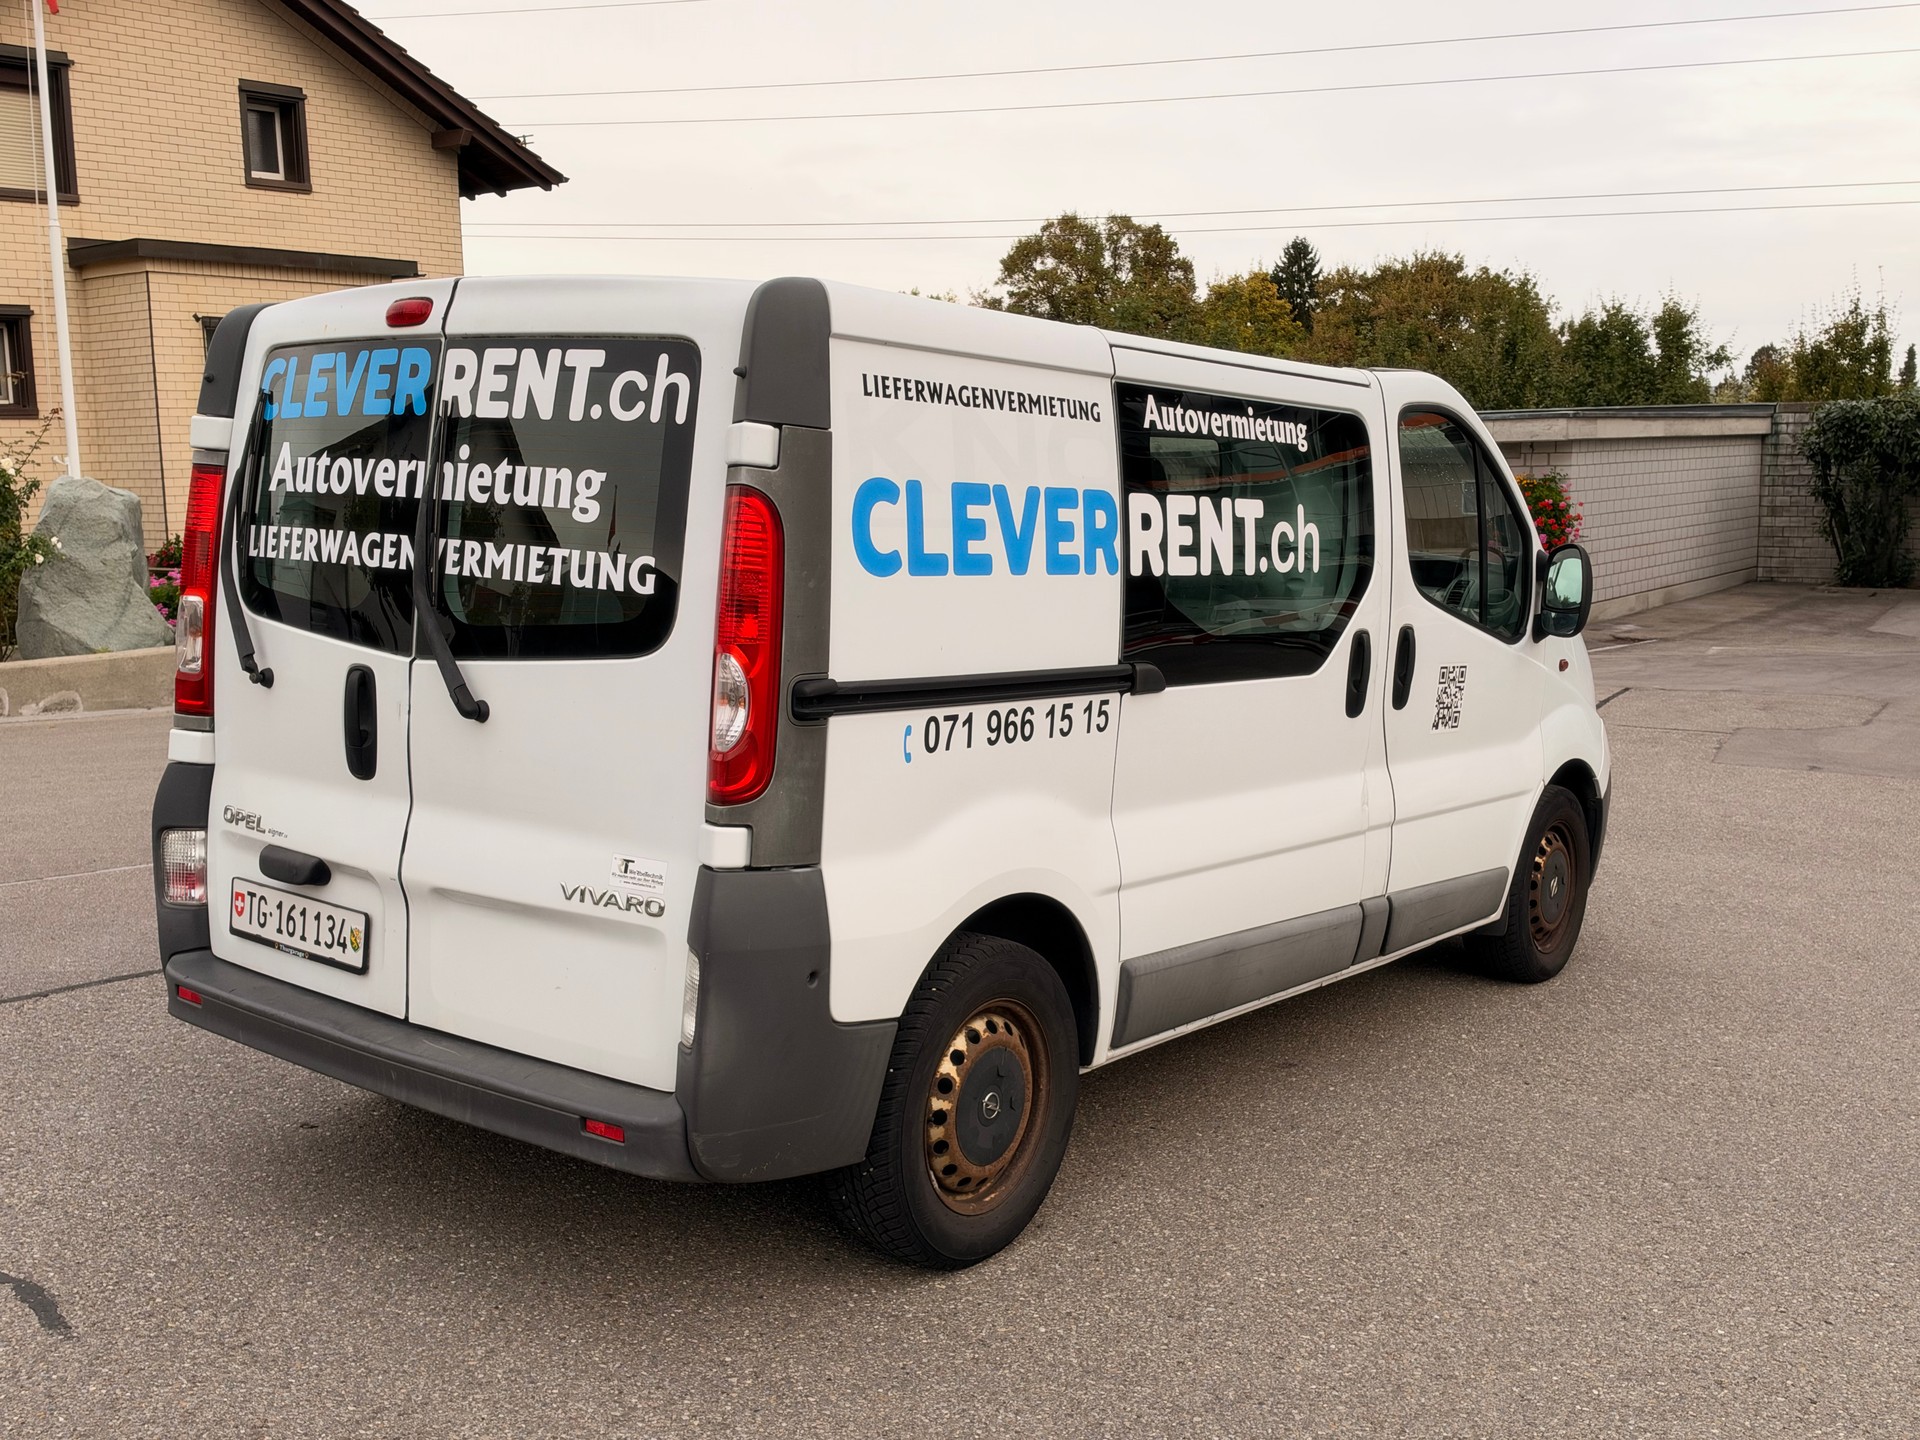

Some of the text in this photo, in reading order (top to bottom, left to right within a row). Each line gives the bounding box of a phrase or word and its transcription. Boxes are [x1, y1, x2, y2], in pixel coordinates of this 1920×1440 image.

[862, 373, 1101, 423] LIEFERWAGENVERMIETUNG
[1143, 394, 1308, 452] Autovermietung
[924, 699, 1110, 753] 071 966 15 15
[223, 805, 266, 834] OPEL
[560, 881, 666, 918] VIVARO
